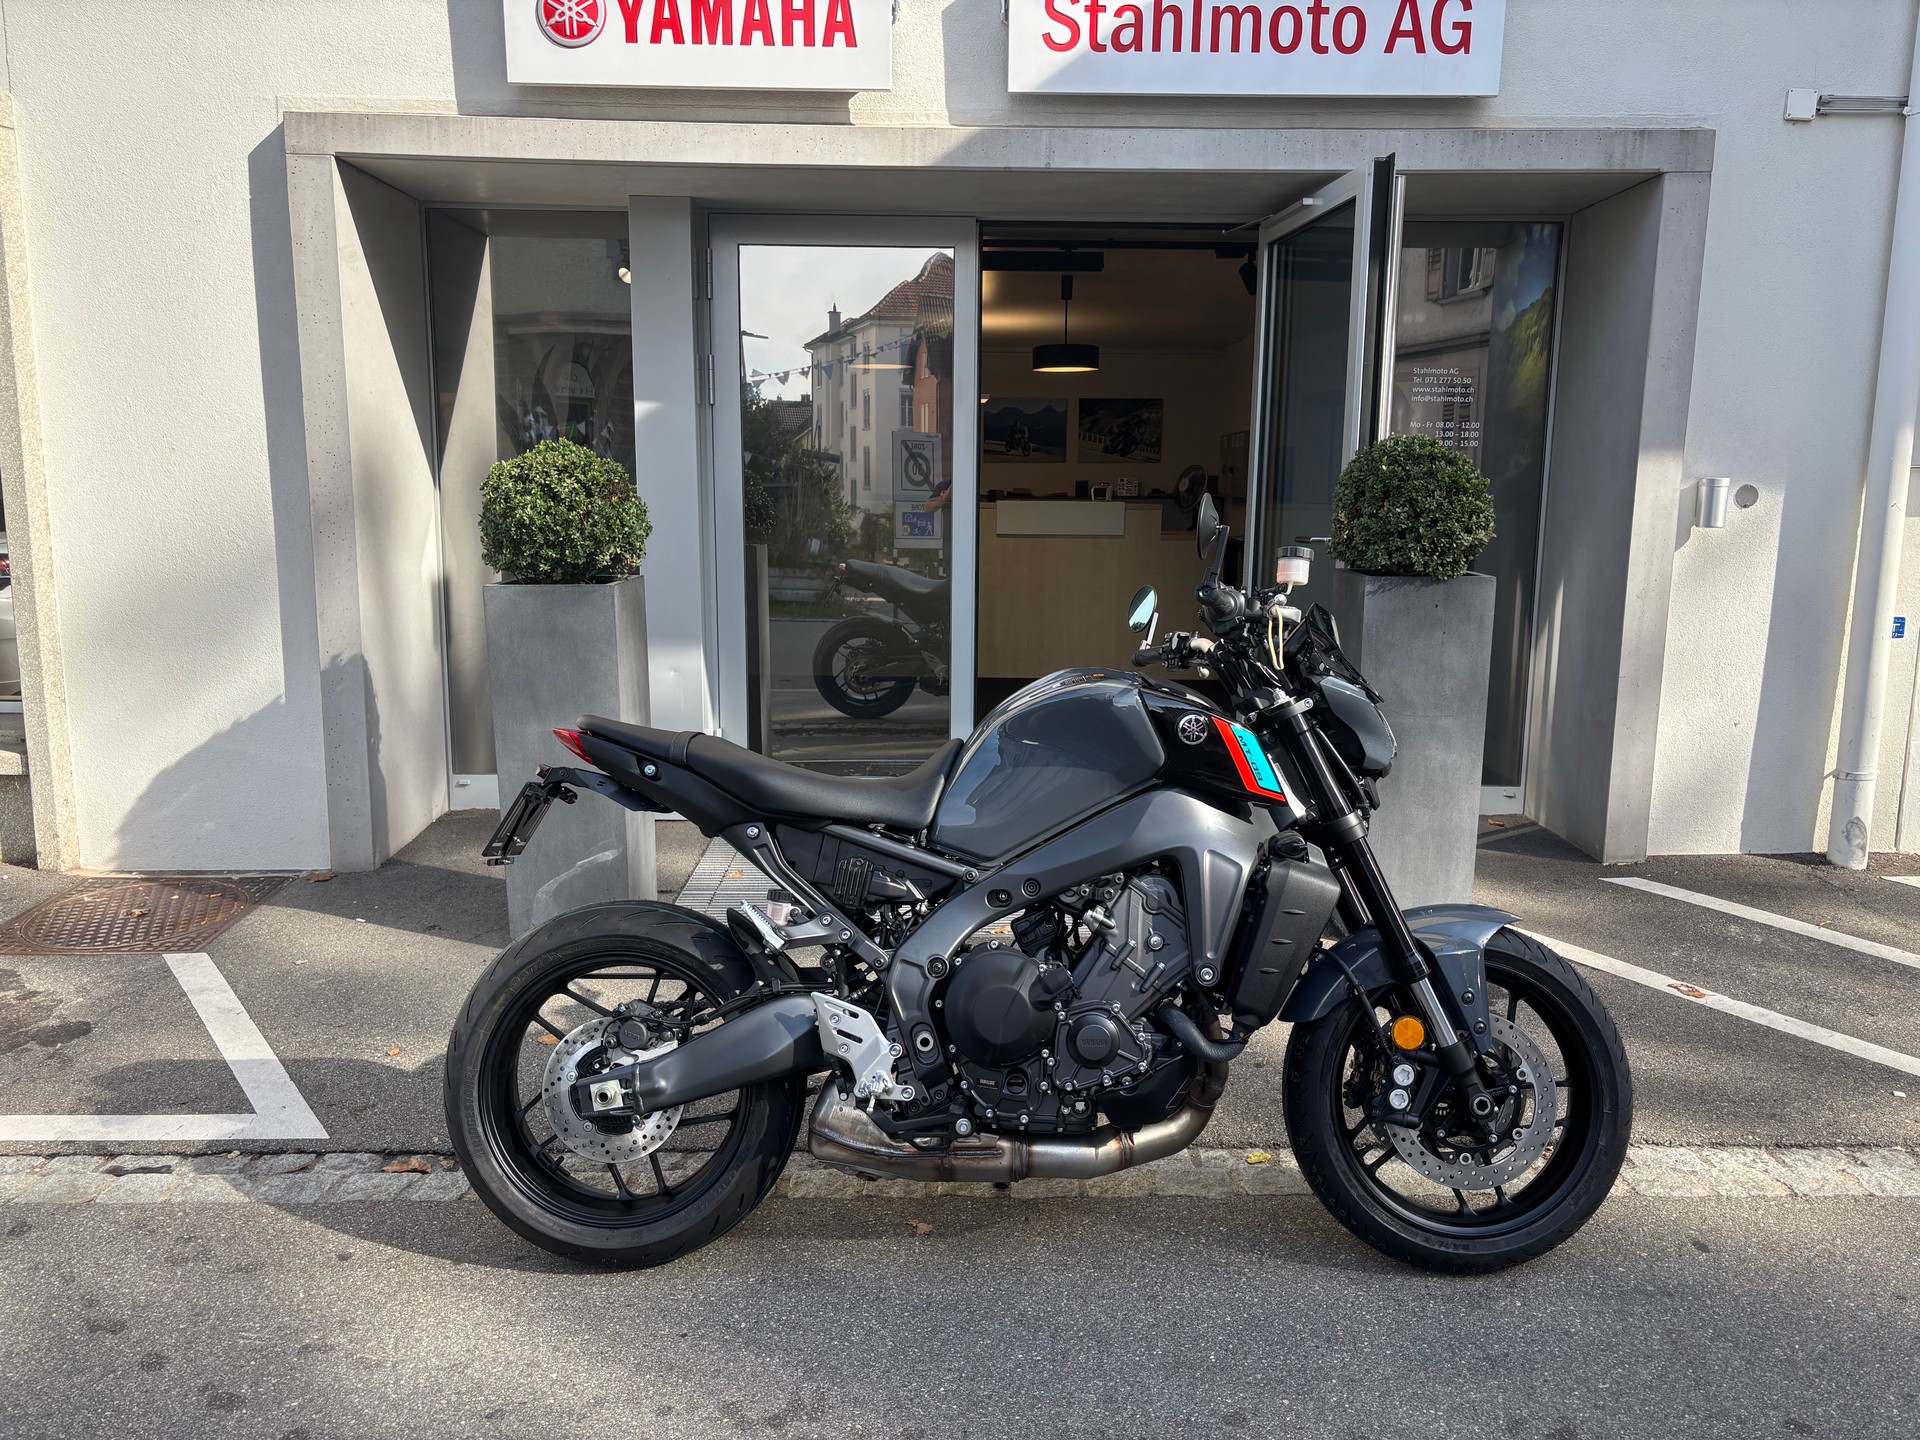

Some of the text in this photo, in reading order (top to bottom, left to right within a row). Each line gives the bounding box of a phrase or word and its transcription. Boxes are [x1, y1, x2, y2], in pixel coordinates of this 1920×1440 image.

[621, 0, 858, 48] YAMAHA
[1042, 0, 1473, 54] Stahlmoto AG
[1413, 367, 1448, 375] Stahlmoto
[1412, 386, 1475, 394] www.stahlmoto.ch
[1411, 395, 1474, 403] info@stahlmoto.ch
[1435, 421, 1455, 429] 08.00
[1461, 421, 1480, 429] 12.00
[1435, 430, 1454, 438] 13.00
[1237, 735, 1264, 782] MT-09
